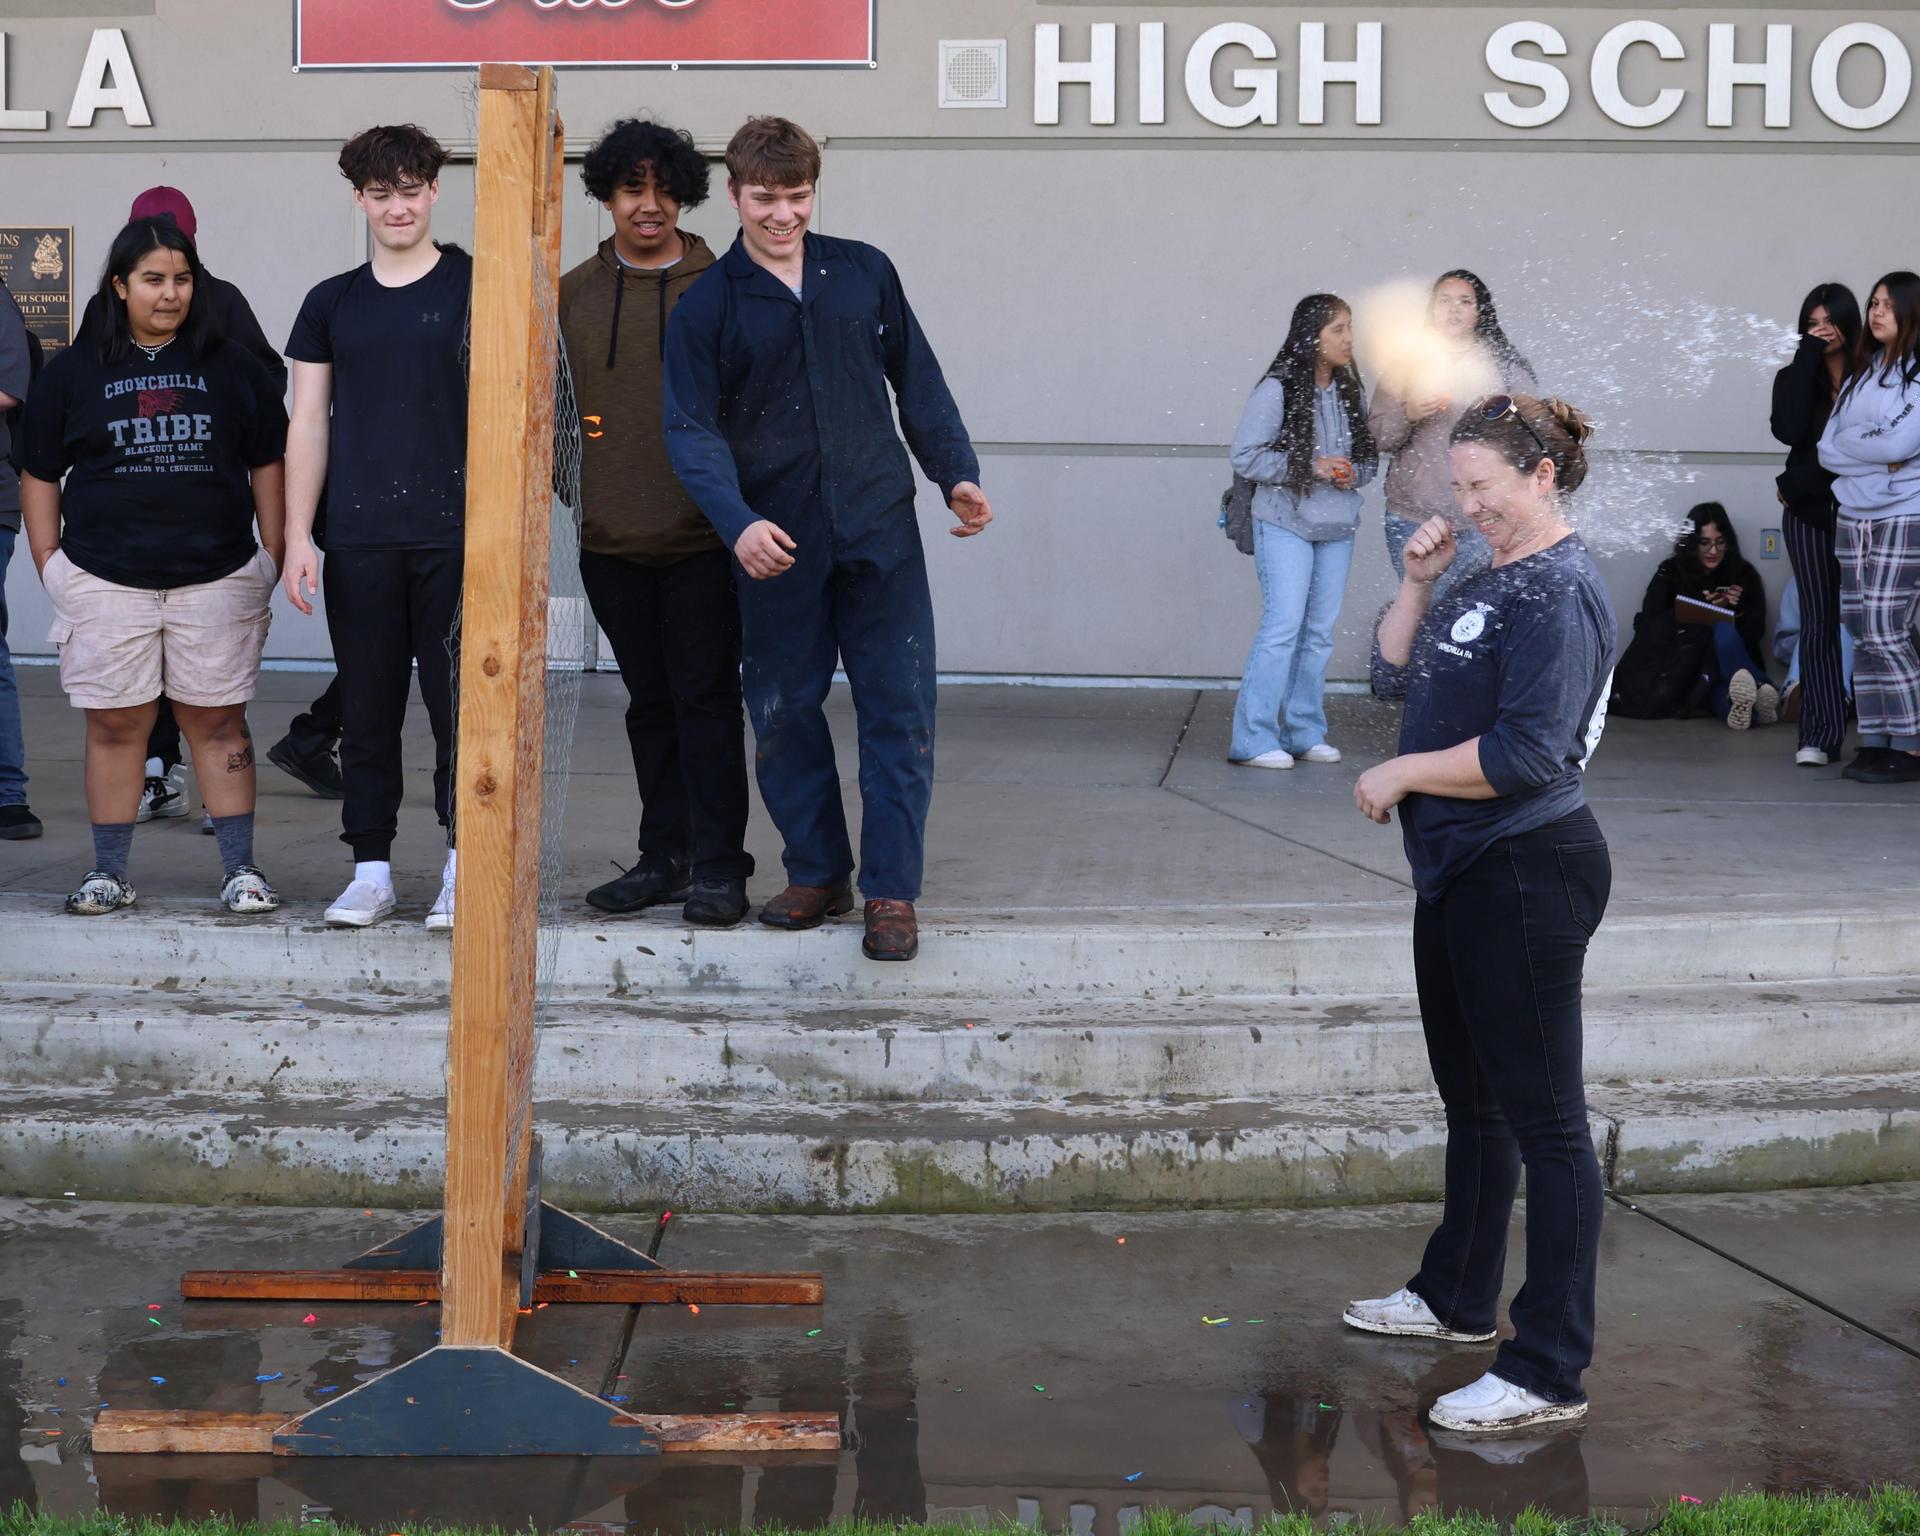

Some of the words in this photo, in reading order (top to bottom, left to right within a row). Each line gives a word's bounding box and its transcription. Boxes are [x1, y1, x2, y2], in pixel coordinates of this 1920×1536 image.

[0, 28, 152, 130] LA
[1034, 21, 1382, 128] HIGH
[1484, 19, 1912, 130] SCHO
[29, 294, 68, 303] SCHOOL
[19, 305, 48, 314] ILITY
[104, 374, 208, 399] CHOWCHILLA
[107, 413, 212, 447] TRIBE
[125, 444, 174, 456] BLACKOUT
[178, 443, 204, 452] GAME
[154, 455, 175, 464] 2018
[129, 465, 152, 473] PALOS
[170, 465, 214, 473] CHOWCHILLA
